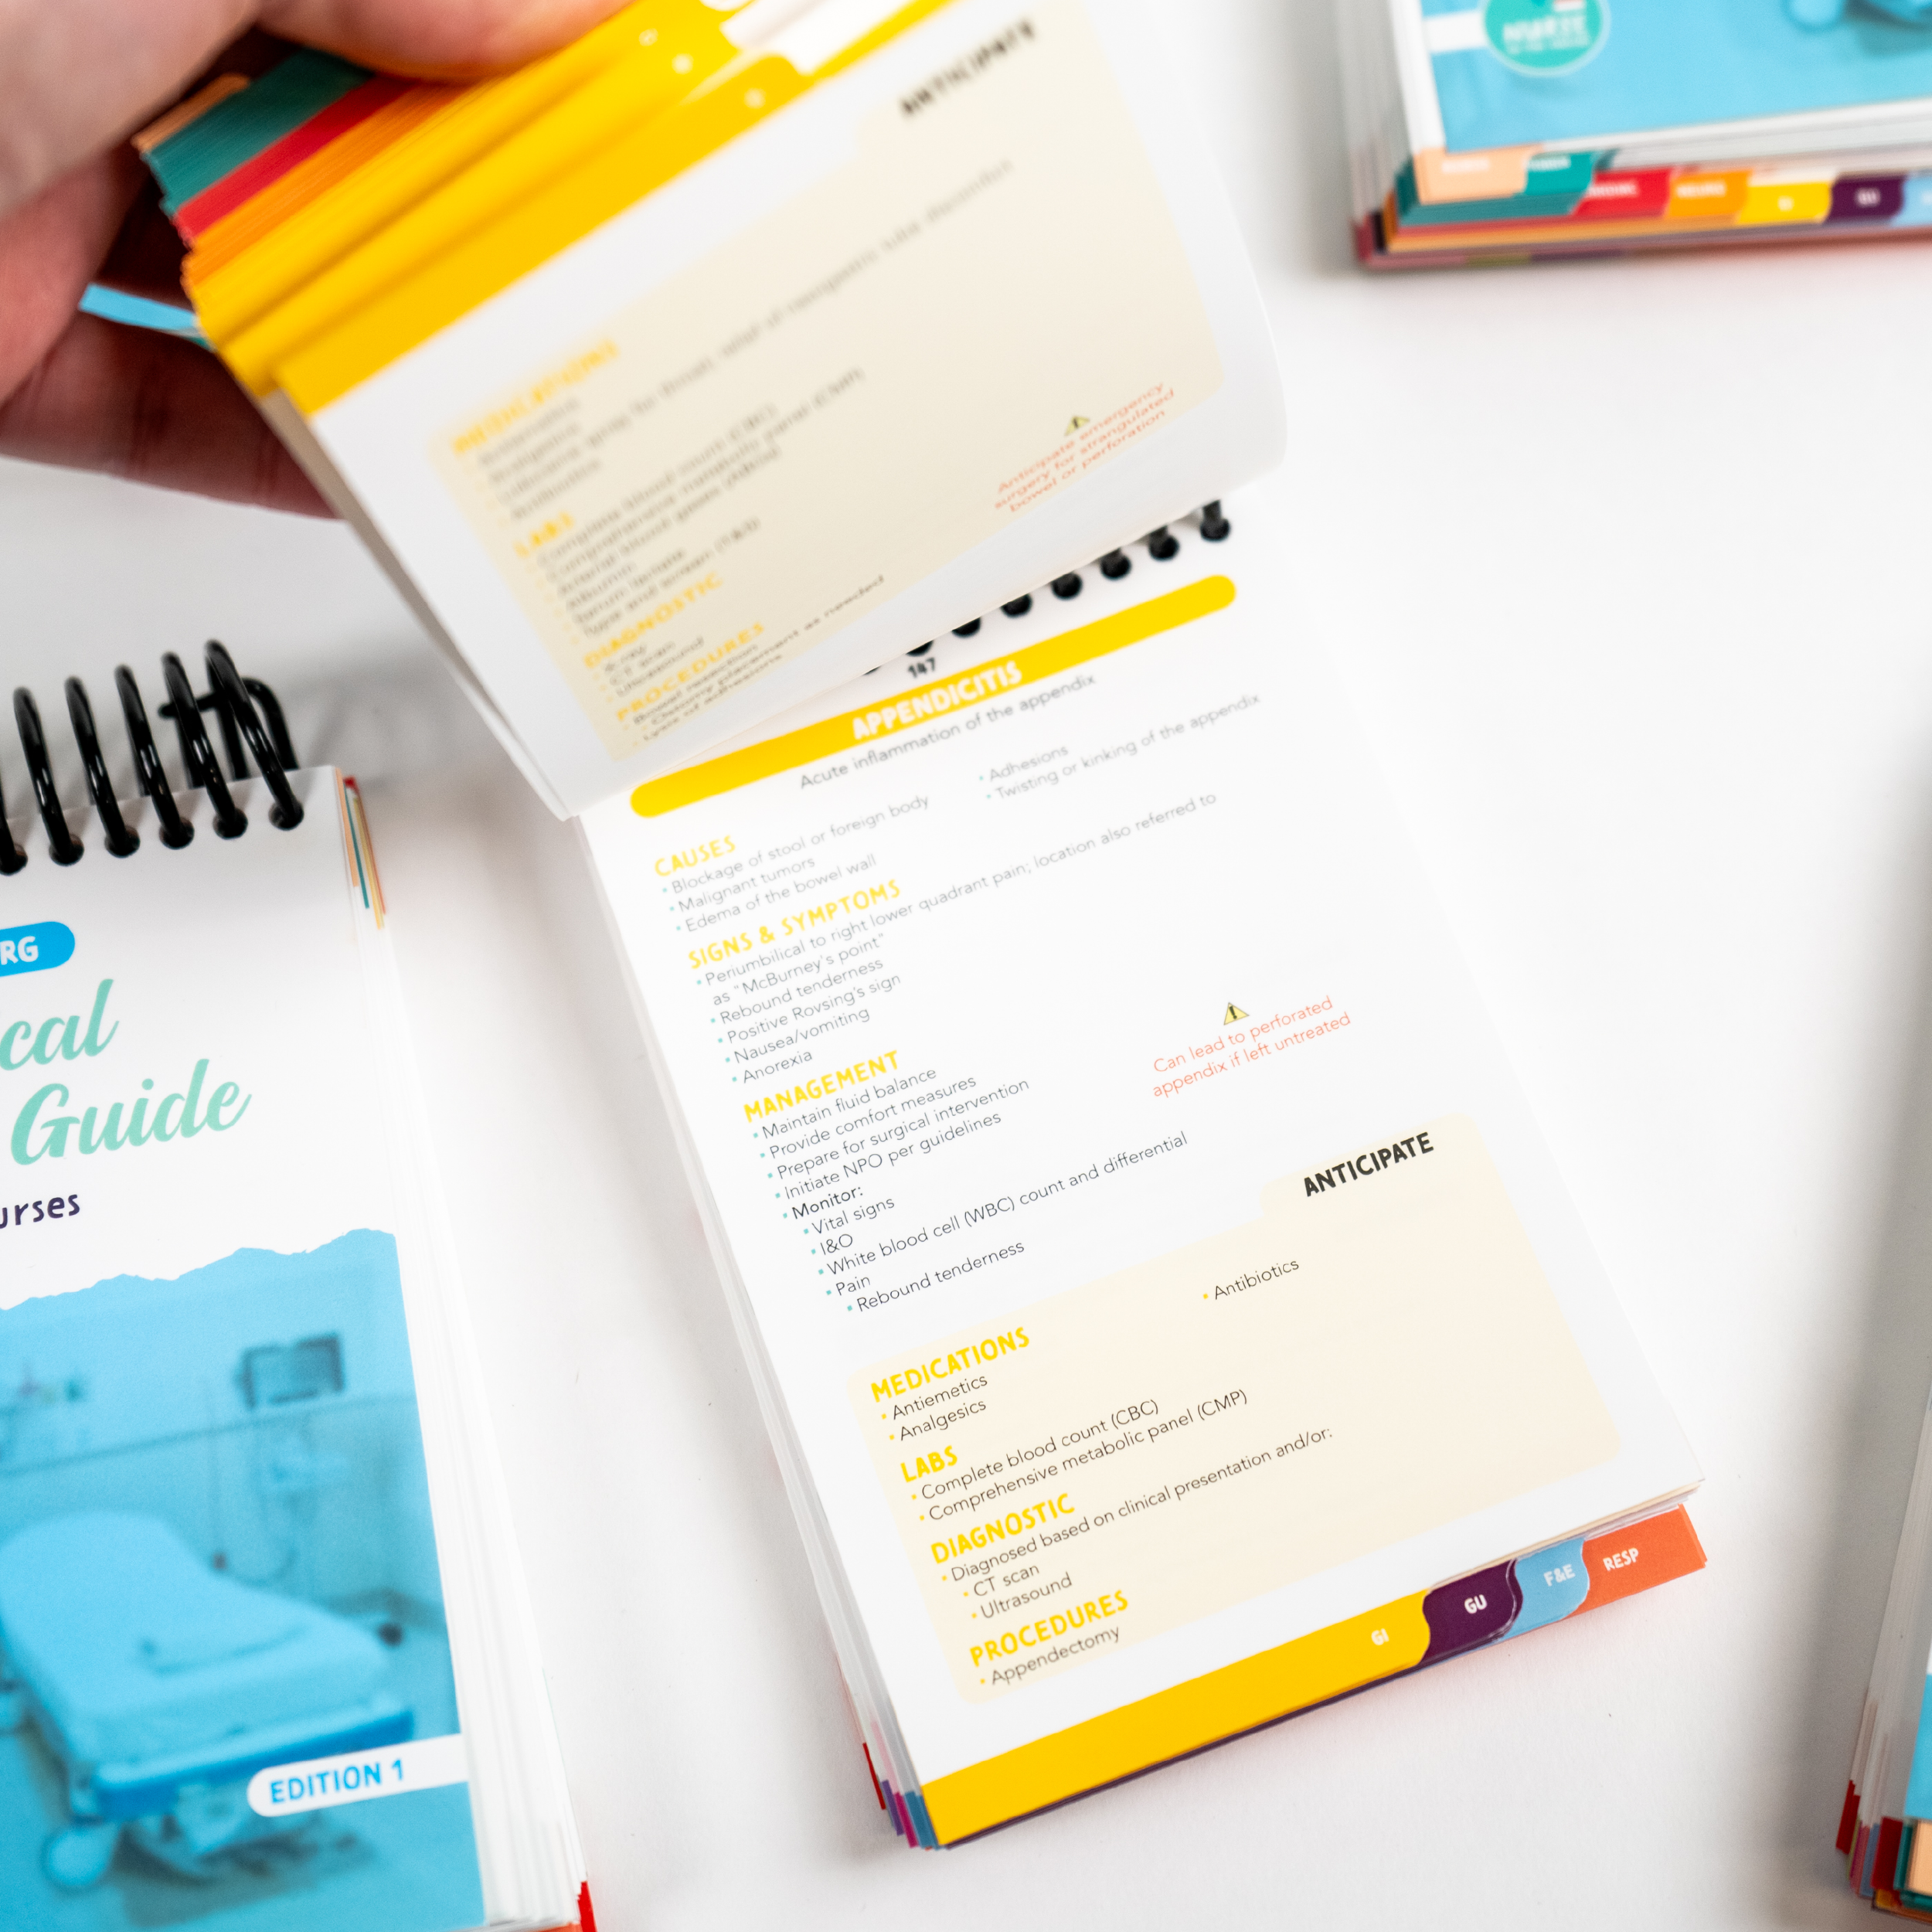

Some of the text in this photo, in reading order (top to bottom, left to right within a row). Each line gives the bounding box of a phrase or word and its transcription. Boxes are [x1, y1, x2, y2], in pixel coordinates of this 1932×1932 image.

[994, 387, 1174, 509] surgery for strangulated
[998, 383, 1163, 493] Anticipate emergency
[1009, 410, 1165, 512] bowel or perforation
[583, 573, 721, 668] DIAGNOSTIC
[616, 622, 764, 721] PROCEDURES
[852, 660, 1023, 741] APPENDICITIS
[907, 657, 937, 679] 147
[801, 675, 1095, 789] Acute inflammation of the appendix
[989, 746, 1069, 781] Adhesions
[994, 695, 1260, 798] Twisting or kinking of the appendix
[654, 835, 735, 876] CAUSES
[671, 794, 928, 893] Blockage of stool or foreign body
[678, 858, 815, 912] Malignant tumors
[685, 853, 876, 932] Edema of the bowel wall
[705, 794, 1216, 985] Periumbilical to right lower quadrant pain; location also referred to
[688, 932, 753, 969] SIGNS
[781, 879, 900, 936] SYMPTOMS
[713, 992, 730, 1005] as
[719, 959, 883, 1024] Rebound tenderness
[726, 1015, 787, 1043] Positive
[869, 975, 900, 993] sign
[733, 1009, 869, 1063] Nausea/vomiting
[743, 1051, 812, 1083] Anorexia
[1152, 1011, 1350, 1097] appendix if left untreated
[1153, 995, 1332, 1072] Can lead to perforated
[11, 1059, 253, 1165] Guide
[743, 1049, 897, 1123] MANAGEMENT
[761, 1070, 936, 1138] Maintain fluid balance
[769, 1077, 976, 1158] Provide comfort measures
[777, 1080, 1029, 1179] Prepare for surgical intervention
[784, 1113, 1001, 1199] Initiate NPO per guidelines
[1304, 1131, 1434, 1197] ANTICIPATE
[791, 1186, 862, 1219] Monitor:
[811, 1198, 894, 1233] Vital signs
[826, 1131, 1187, 1274] White blood cell (WBC) count and differential
[835, 1276, 870, 1295] Pain
[856, 1242, 1024, 1311] Rebound tenderness
[1215, 1260, 1299, 1300] Antibiotics
[870, 1326, 1029, 1403] MEDICATIONS
[893, 1376, 988, 1420] Antiemetics
[900, 1400, 986, 1440] Analgesics
[921, 1399, 1158, 1498] Complete blood count (CBC)
[929, 1389, 1247, 1519] Comprehensive metabolic panel (CMP)
[900, 1444, 957, 1482] LABS
[930, 1492, 1075, 1564] DIAGNOSTIC
[951, 1536, 1037, 1581] Diagnosed
[1039, 1515, 1090, 1546] based
[1094, 1512, 1114, 1526] on
[1117, 1485, 1171, 1516] clinical
[1174, 1451, 1271, 1499] presentation
[973, 1565, 1039, 1596] CT scan
[980, 1570, 1072, 1618] Ultrasound
[1543, 1564, 1576, 1587] F&E
[1603, 1548, 1640, 1572] RESP
[969, 1589, 1128, 1667] PROCEDURES
[1371, 1628, 1390, 1646] GI
[1464, 1594, 1488, 1614] GU
[992, 1626, 1118, 1685] Appendectomy
[270, 1758, 404, 1804] EDITION 1
